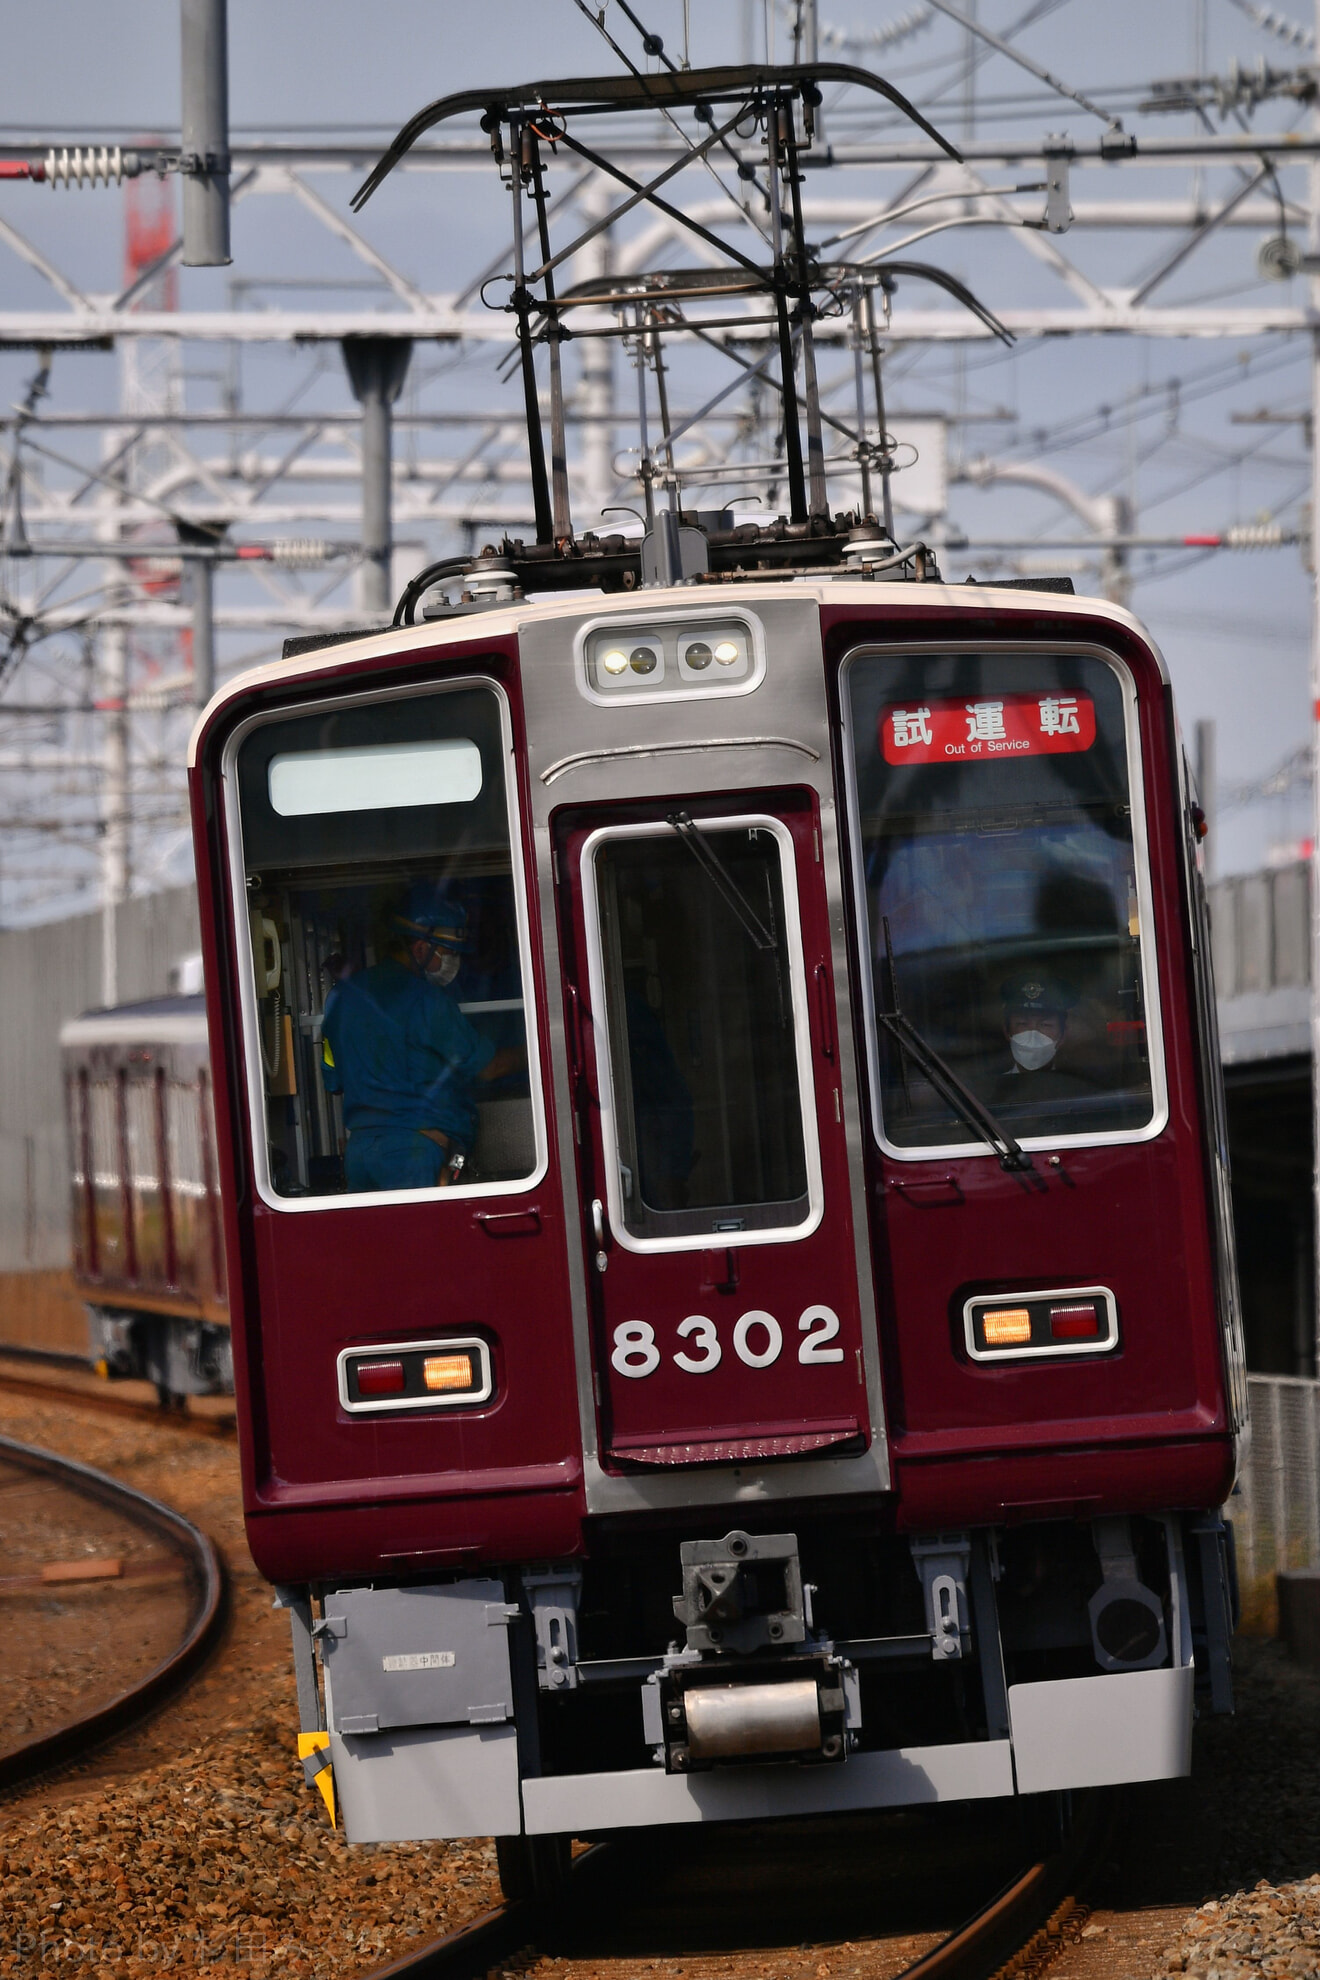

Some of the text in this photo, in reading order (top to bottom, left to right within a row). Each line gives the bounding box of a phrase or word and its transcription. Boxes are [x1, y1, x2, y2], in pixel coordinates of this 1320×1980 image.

[892, 698, 1080, 747] 試運転
[944, 739, 1030, 755] Out of Service
[611, 1304, 844, 1378] 8302
